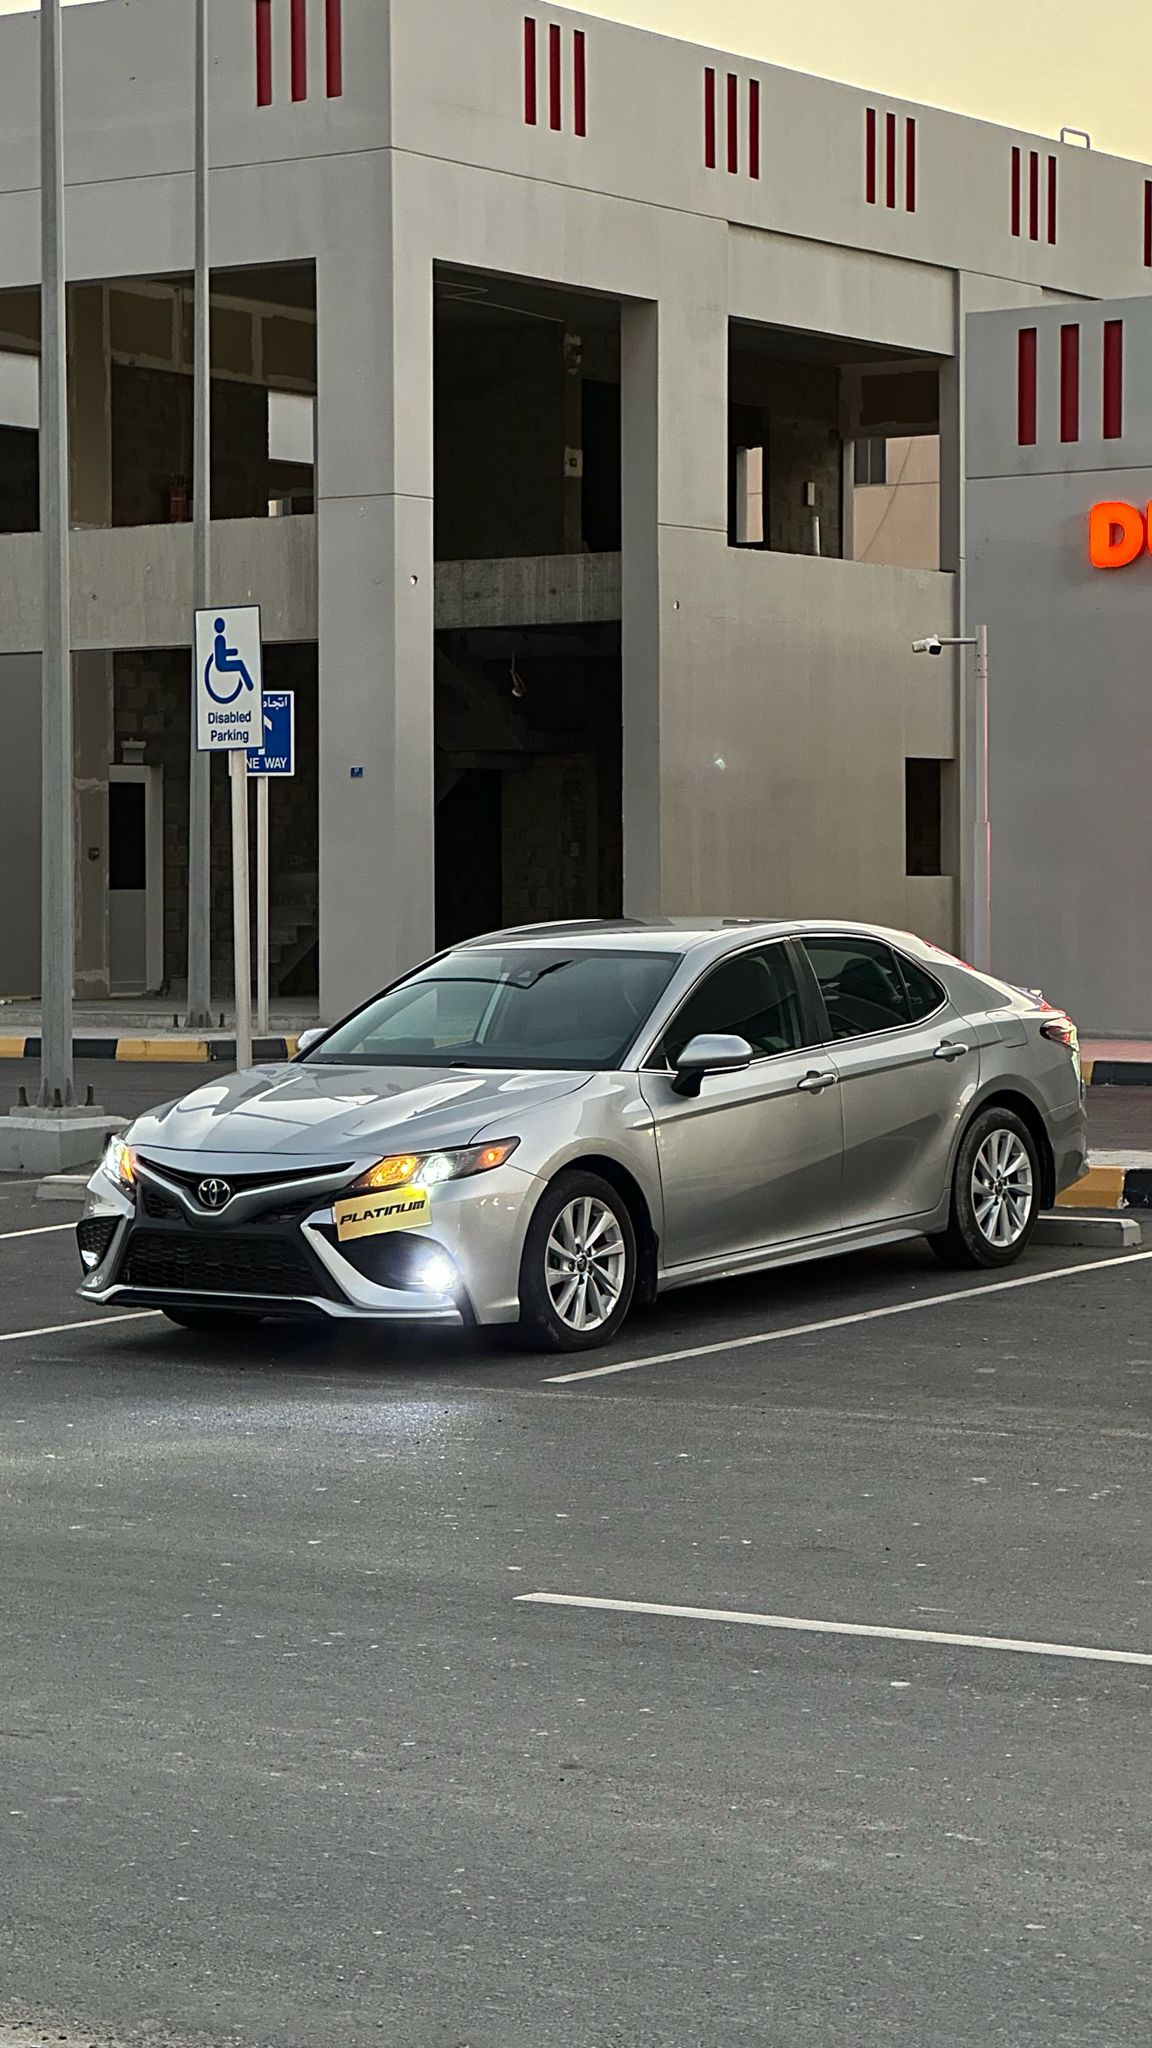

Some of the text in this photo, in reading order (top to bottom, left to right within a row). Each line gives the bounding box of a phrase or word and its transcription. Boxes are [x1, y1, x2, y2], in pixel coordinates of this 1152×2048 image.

[1088, 500, 1152, 569] D
[208, 711, 251, 724] Disabled
[211, 729, 249, 743] Parking
[246, 757, 288, 769] NE WAY
[340, 1200, 425, 1225] PLATINUM
